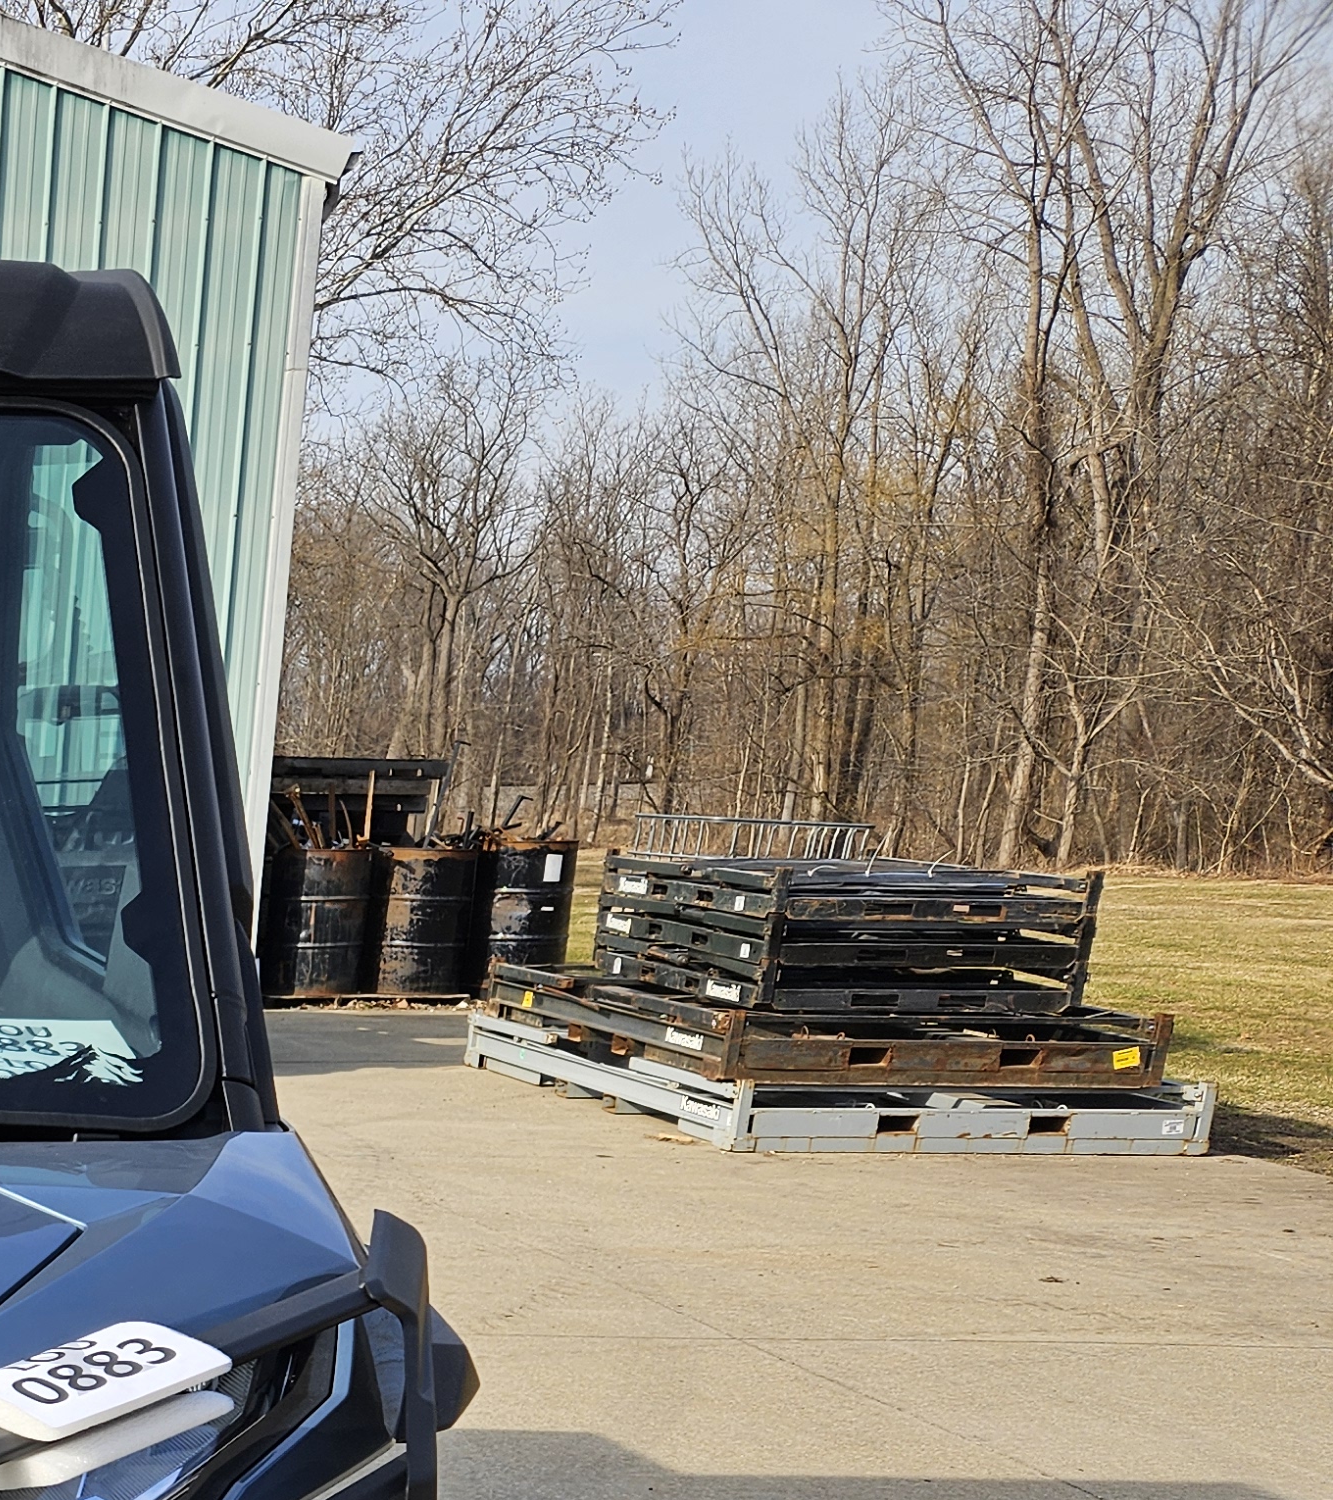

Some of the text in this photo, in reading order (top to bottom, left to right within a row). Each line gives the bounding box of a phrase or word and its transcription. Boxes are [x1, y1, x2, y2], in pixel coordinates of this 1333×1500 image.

[664, 1026, 704, 1051] Kawasaki
[679, 1095, 721, 1121] Kawasaki
[12, 1338, 177, 1404] 0883
